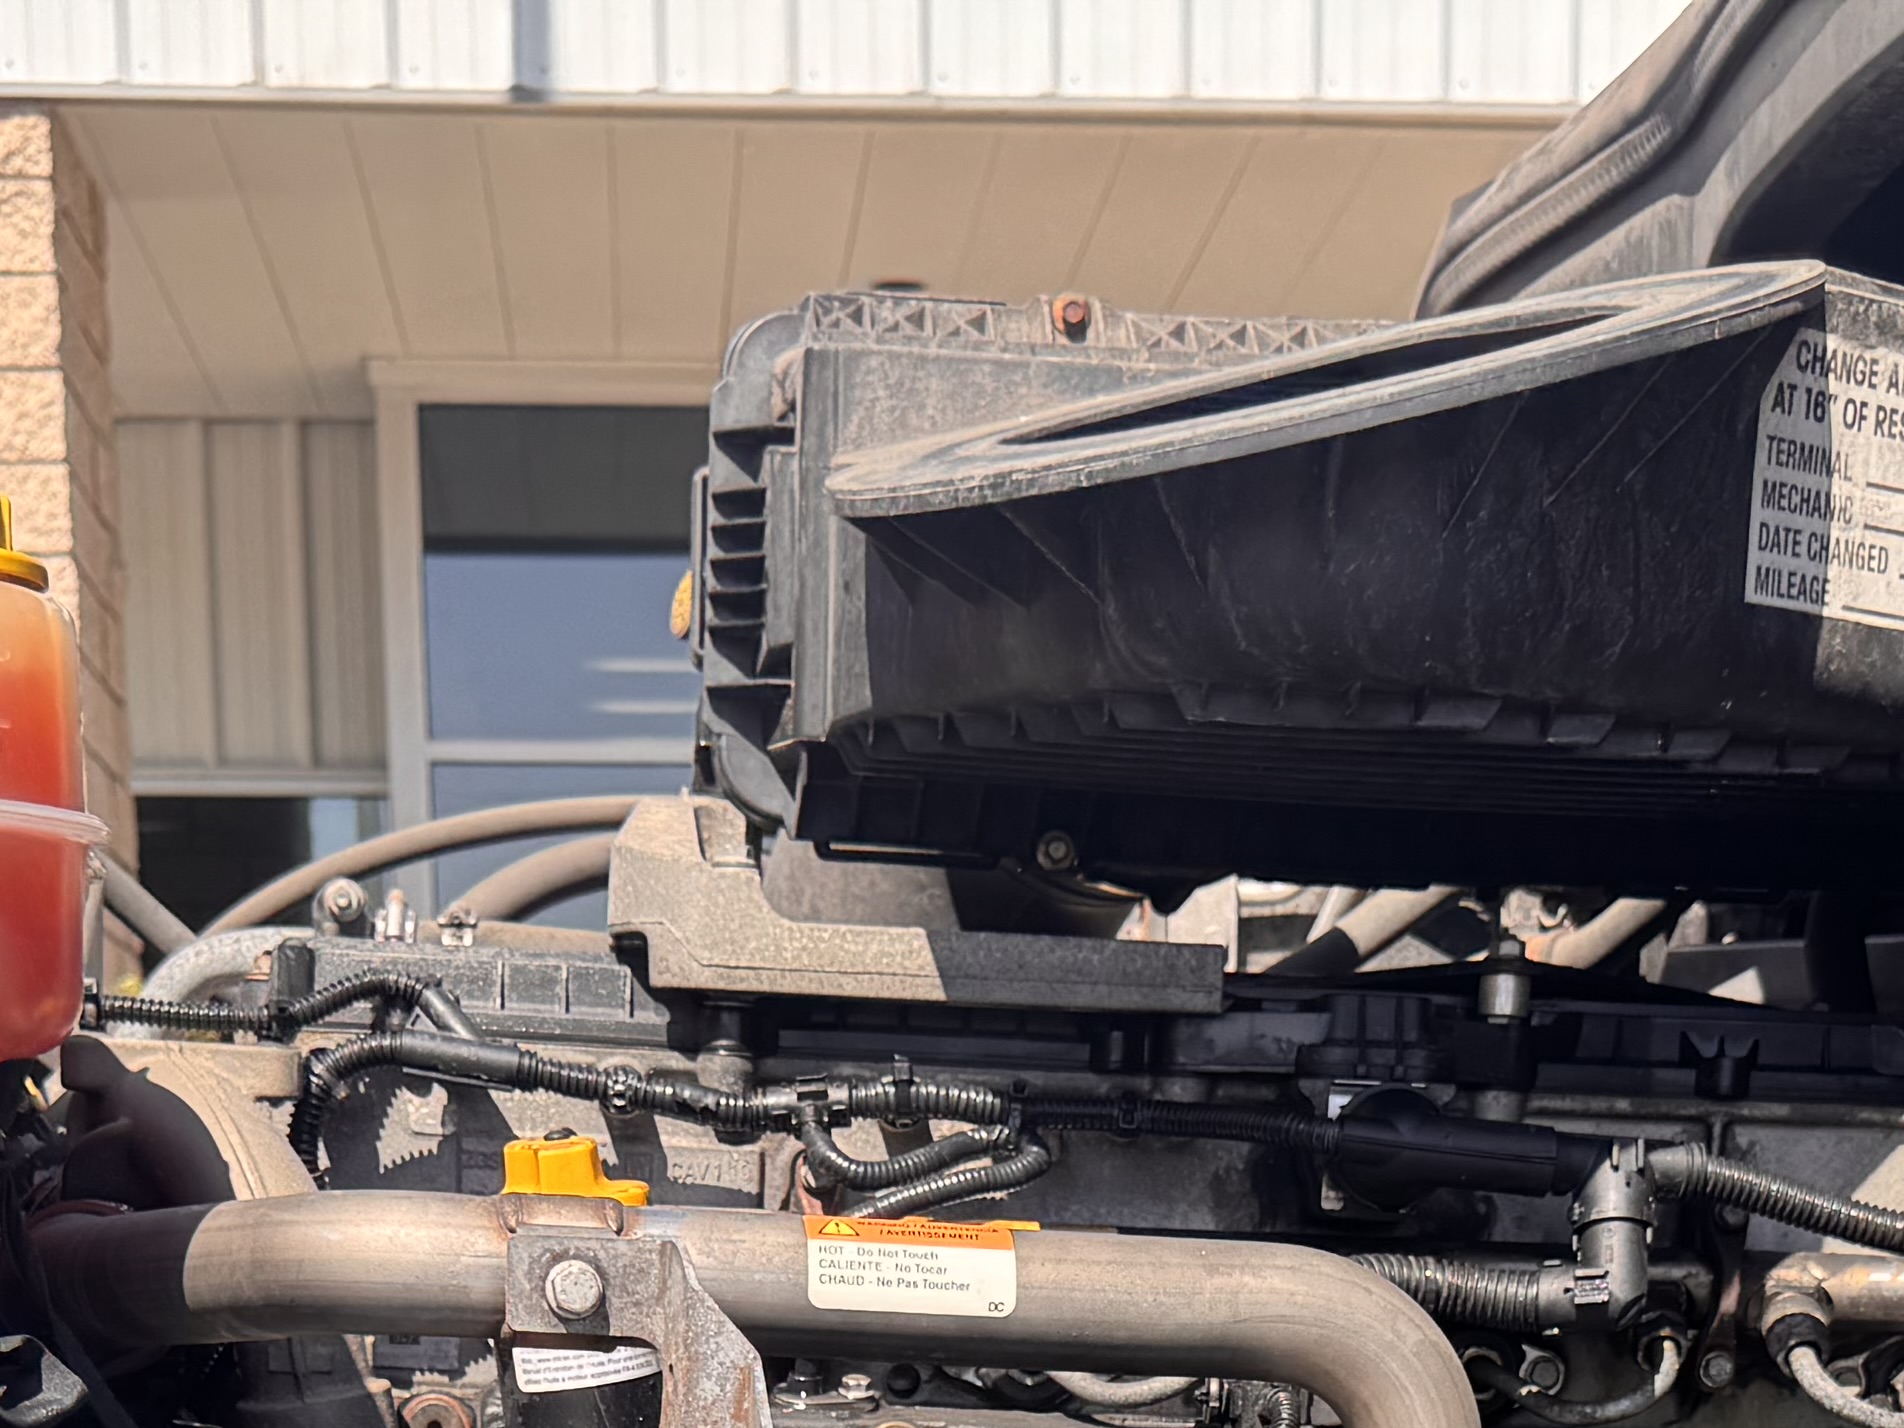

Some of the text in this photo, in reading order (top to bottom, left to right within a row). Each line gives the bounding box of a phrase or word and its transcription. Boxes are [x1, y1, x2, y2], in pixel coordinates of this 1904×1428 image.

[1796, 339, 1879, 389] CHANGE
[1770, 381, 1795, 416] AT
[1804, 387, 1838, 423] 16"
[1842, 398, 1868, 433] OF
[1765, 434, 1853, 482] TERMINAL
[1760, 479, 1853, 525] MECHANIC
[1757, 522, 1889, 575] DATE CHANGED
[1754, 565, 1830, 606] MILEAGE
[819, 1245, 939, 1261] HOT Do Not Touch
[819, 1259, 948, 1275] CALIENTE No Tocar
[819, 1274, 865, 1286] CHAUD
[897, 1278, 919, 1289] Pas
[922, 1279, 971, 1292] Toucher
[988, 1302, 1005, 1313] DC
